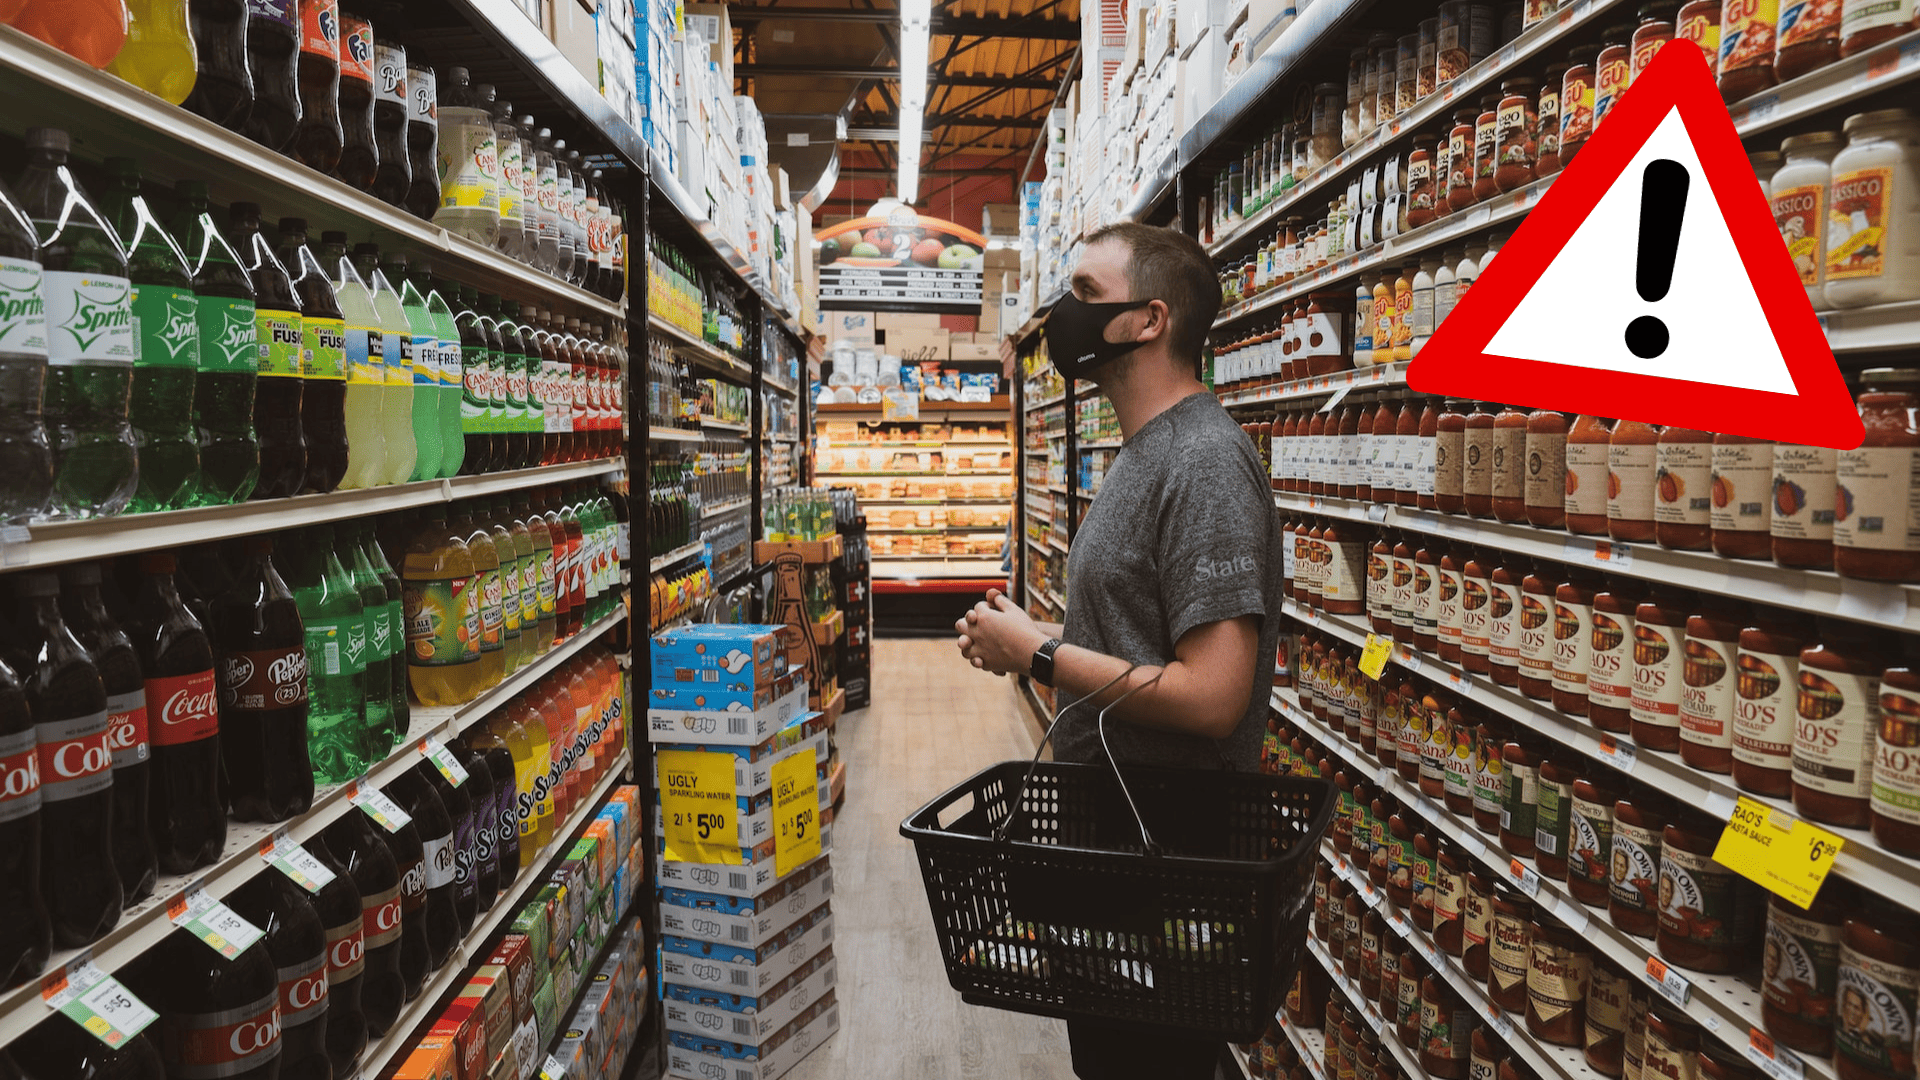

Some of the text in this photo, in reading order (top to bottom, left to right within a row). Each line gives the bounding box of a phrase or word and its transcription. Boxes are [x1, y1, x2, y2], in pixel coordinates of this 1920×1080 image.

[1498, 111, 1521, 127] ego
[1409, 165, 1427, 179] ego
[892, 233, 912, 261] 2
[165, 315, 197, 341] Spri
[285, 652, 301, 668] Dr
[1591, 651, 1621, 672] AO'S
[1633, 666, 1666, 689] AO'S
[281, 688, 297, 700] 23
[1736, 700, 1776, 725] AO'S
[1797, 719, 1839, 748] AO'S
[668, 775, 698, 788] UGLY
[777, 779, 795, 799] UGLY
[669, 789, 731, 800] SPARKLING WATER
[673, 813, 683, 826] 2/
[1732, 804, 1764, 828] RAO'S
[1631, 829, 1661, 844] Charity
[1726, 819, 1773, 847] PASTA SAUCE
[1633, 850, 1654, 880] OWN
[1676, 852, 1706, 868] Charity
[1678, 875, 1699, 908] OWN
[377, 903, 402, 931] Co
[1495, 935, 1526, 953] Organic
[1786, 942, 1810, 980] OWN
[1547, 997, 1573, 1008] GARLIC
[1874, 992, 1907, 1035] OWN
